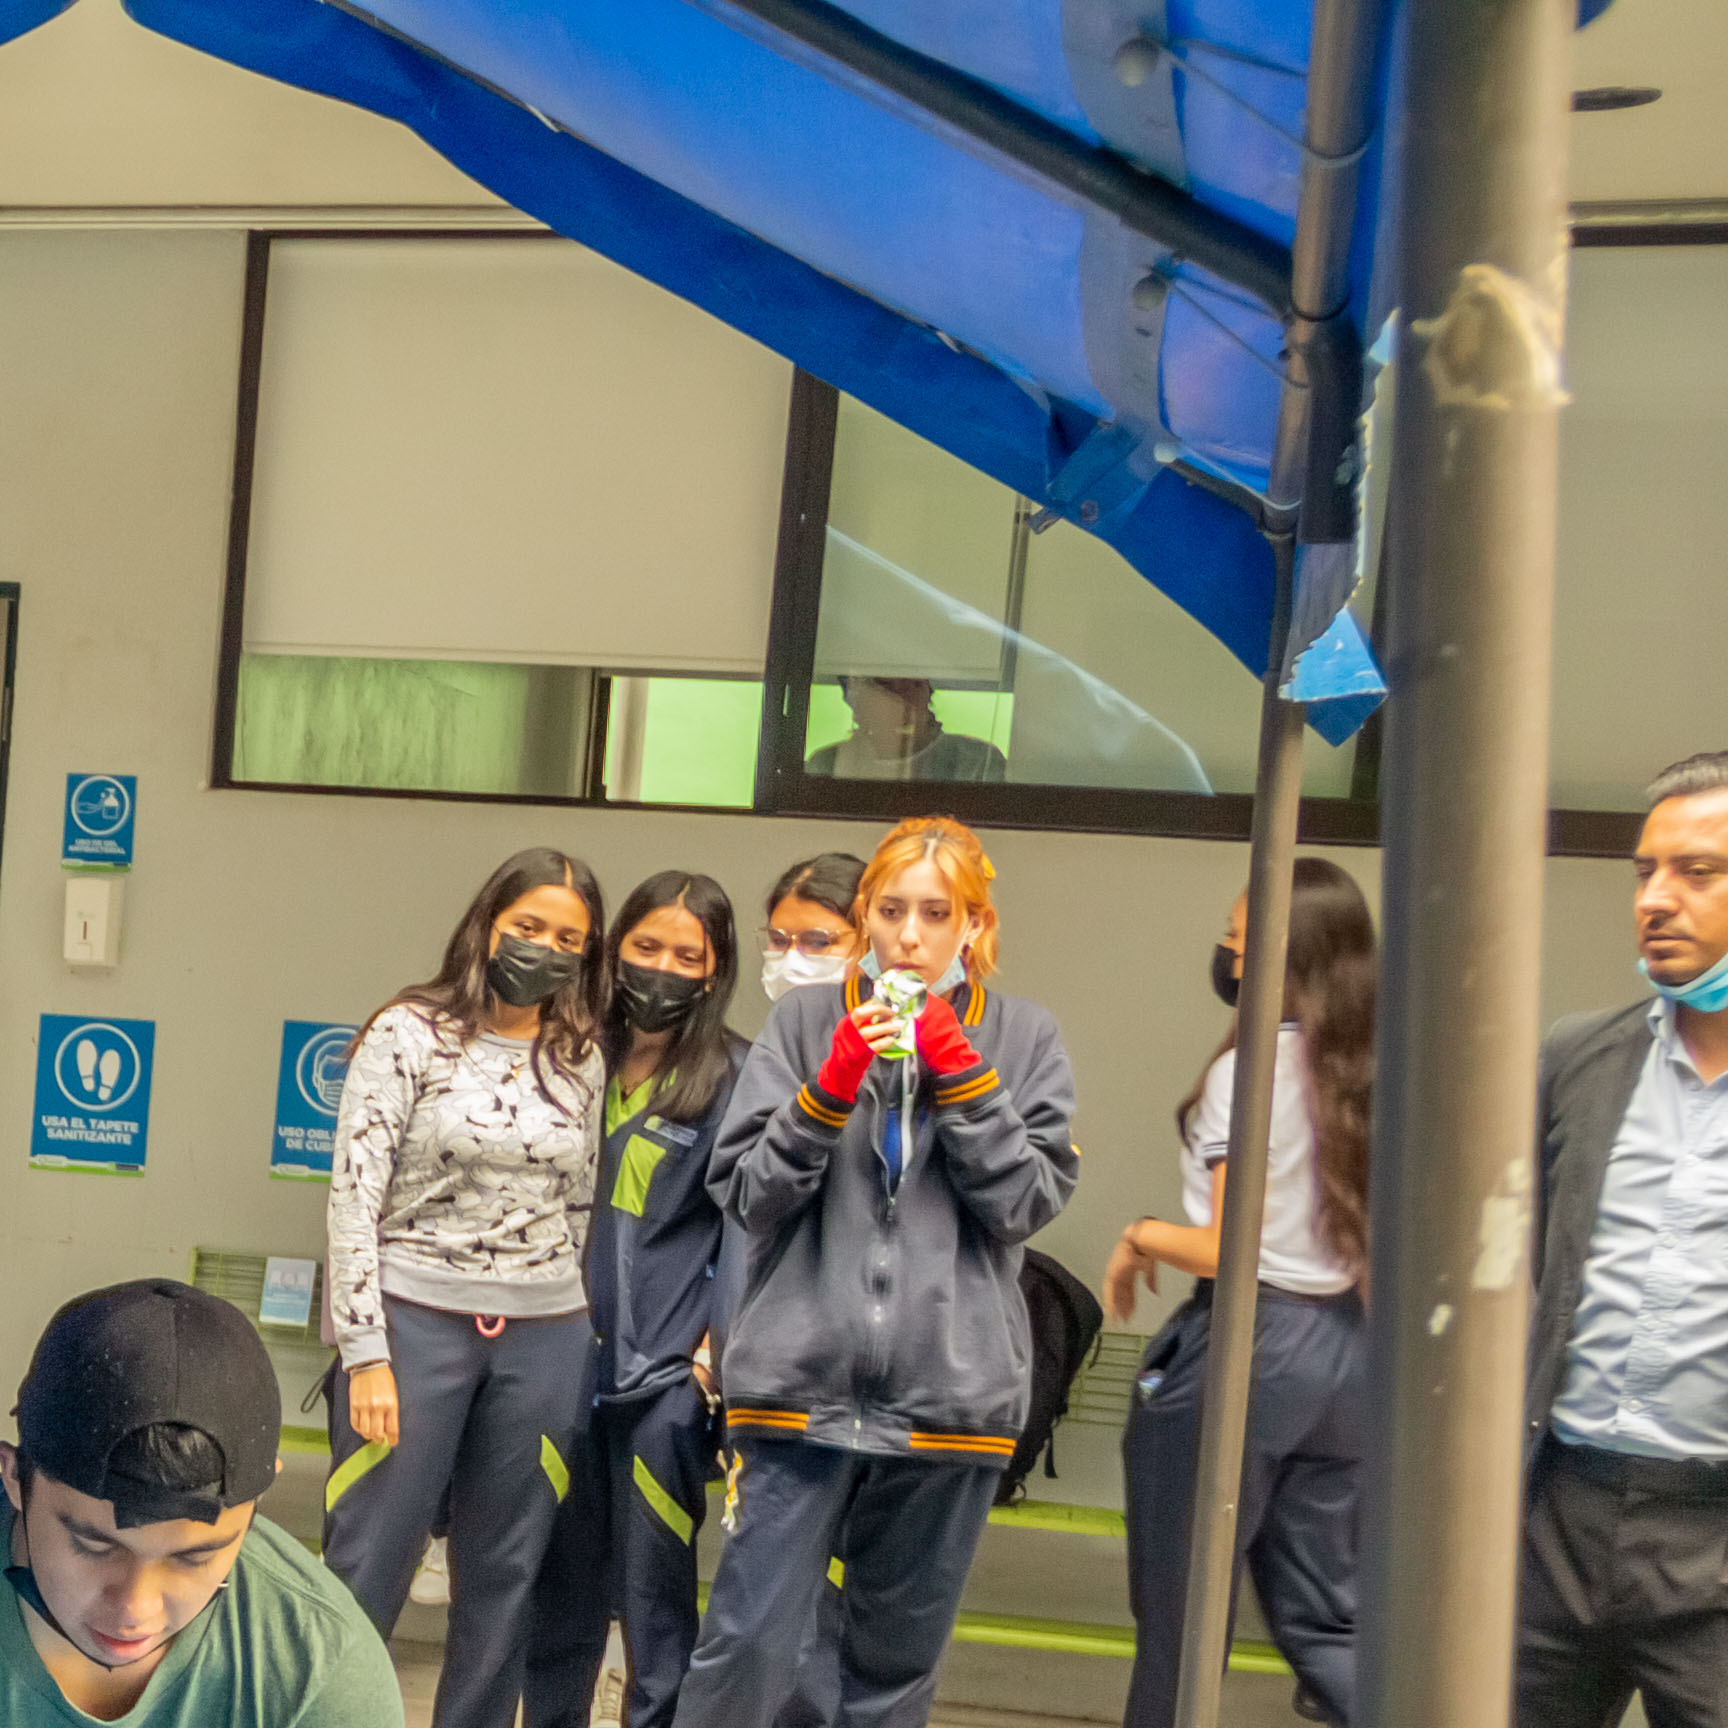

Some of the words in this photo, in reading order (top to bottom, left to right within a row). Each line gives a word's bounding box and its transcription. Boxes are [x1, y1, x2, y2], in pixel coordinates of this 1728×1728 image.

[42, 1115, 68, 1127] USA
[71, 1117, 86, 1129] EL
[47, 1127, 132, 1145] SANITIZANTE
[278, 1125, 304, 1138] USO
[285, 1137, 303, 1150] DE
